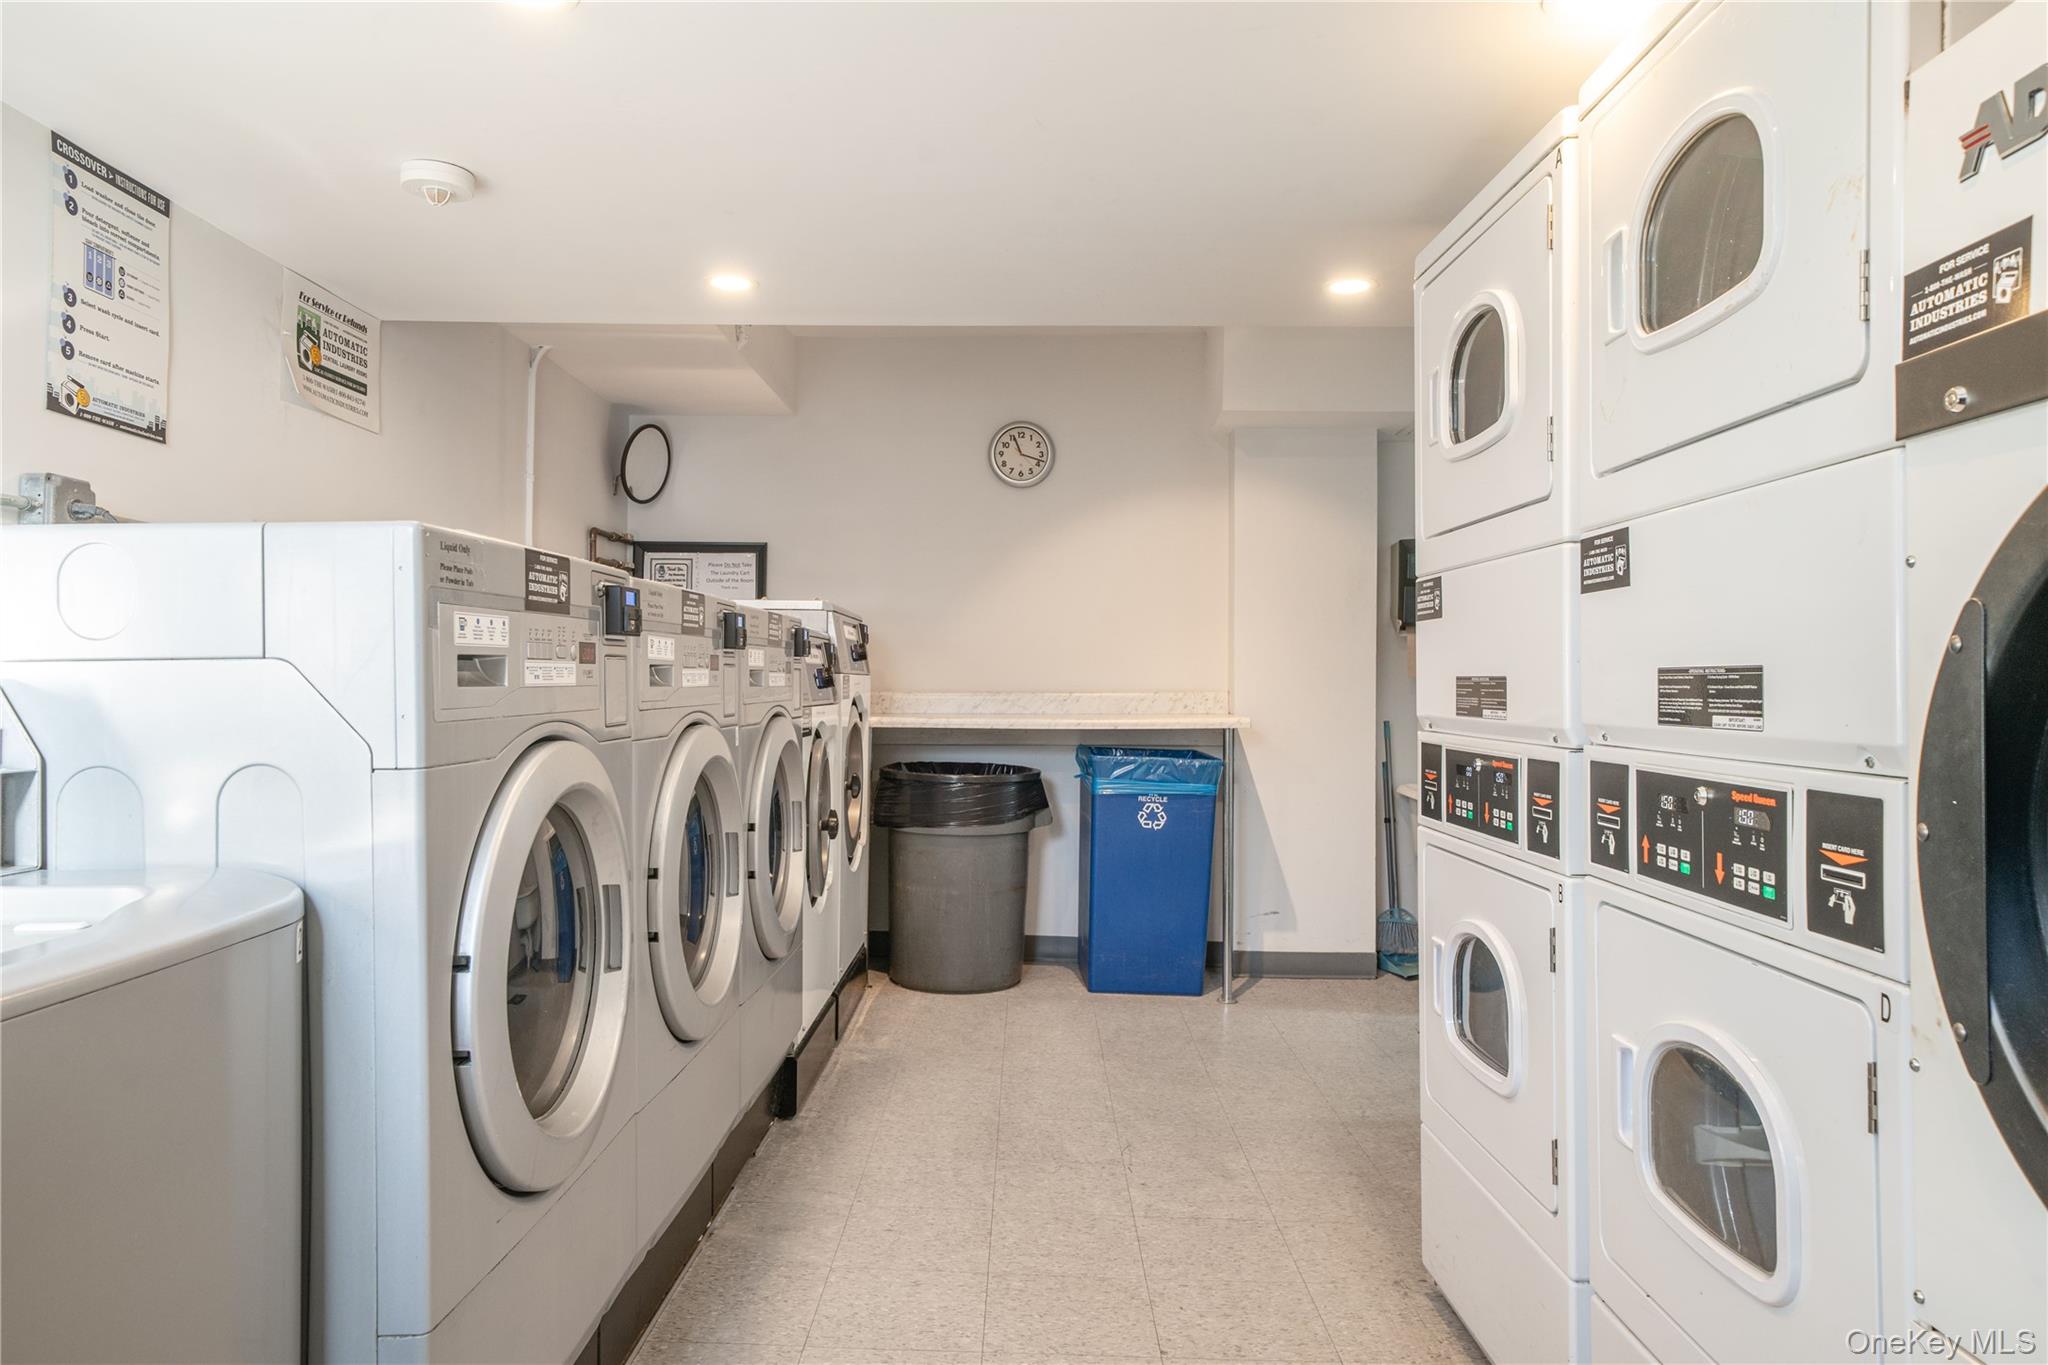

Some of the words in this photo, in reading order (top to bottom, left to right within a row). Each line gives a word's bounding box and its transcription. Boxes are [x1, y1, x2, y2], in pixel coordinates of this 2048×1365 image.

[56, 139, 108, 179] CROSSOVER
[1555, 147, 1563, 168] A
[68, 174, 73, 184] 1
[68, 201, 74, 210] 2
[1939, 259, 1955, 274] FOR
[1955, 243, 1990, 266] SERVICE
[67, 293, 73, 302] 3
[1910, 272, 1989, 317] AUTOMATIC
[298, 290, 311, 302] For
[311, 297, 335, 317] Service
[335, 311, 342, 320] or
[342, 314, 368, 334] Refunds
[1909, 290, 1988, 333] INDUSTRIES
[66, 319, 72, 329] 4
[79, 324, 95, 336] Press
[322, 327, 368, 357] AUTOMATIC
[65, 345, 71, 355] 5
[322, 340, 368, 369] INDUSTRIES
[1017, 431, 1025, 439] 12
[440, 541, 458, 553] Liquid
[458, 543, 471, 556] Only
[1583, 553, 1614, 567] AUTOMATIC
[528, 571, 558, 584] AUTOMATIC
[1583, 563, 1614, 577] INDUSTRIES
[528, 582, 558, 595] INDUSTRIES
[1731, 790, 1753, 803] Speed
[1821, 842, 1837, 851] INSERT
[1837, 844, 1850, 854] CARD
[1850, 847, 1864, 857] HERE
[1880, 992, 1892, 1023] D
